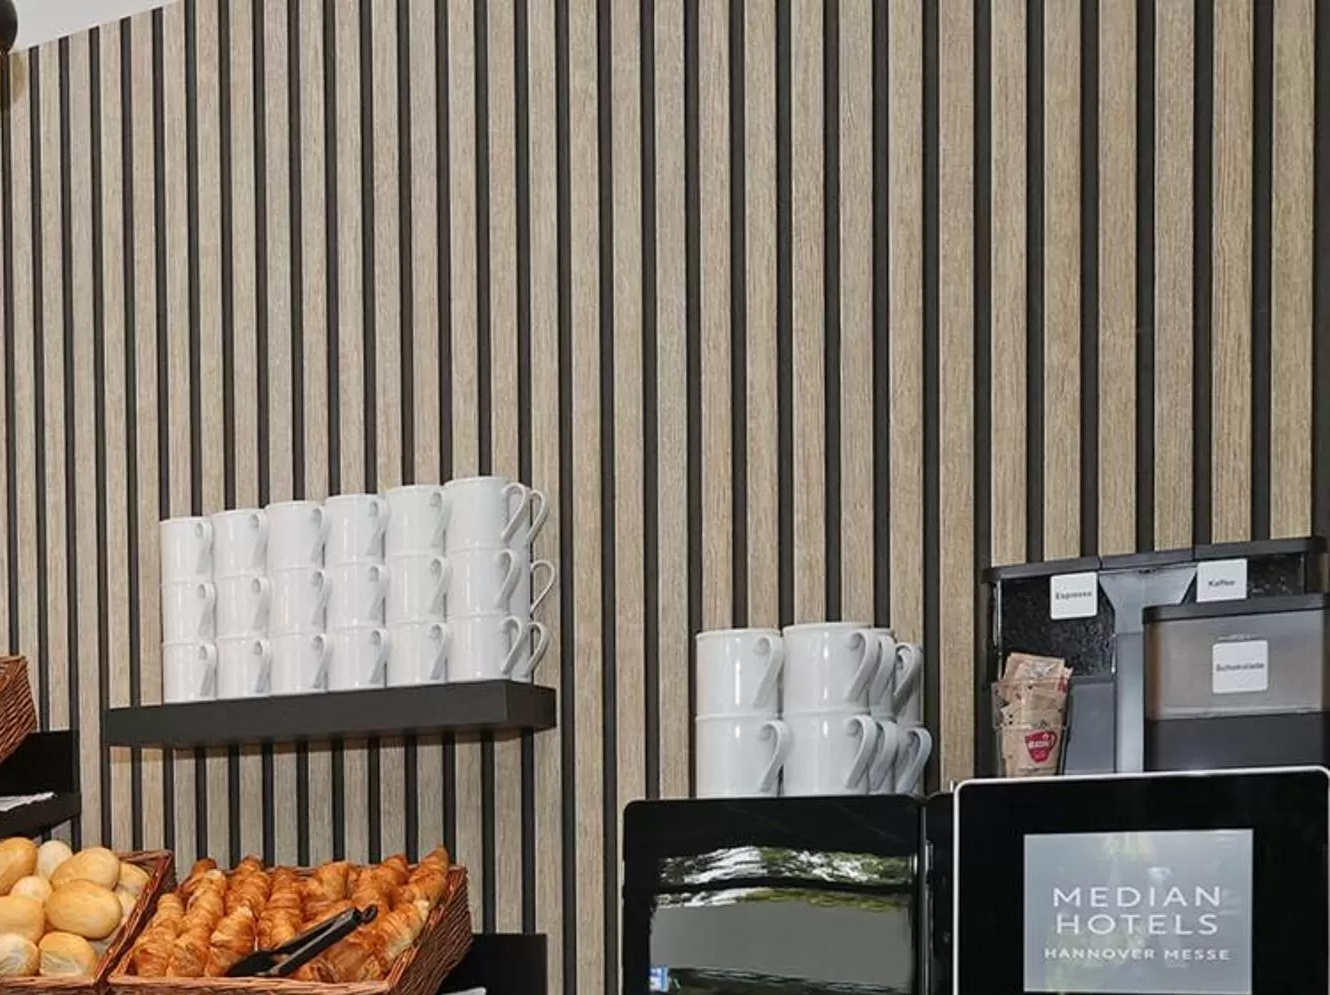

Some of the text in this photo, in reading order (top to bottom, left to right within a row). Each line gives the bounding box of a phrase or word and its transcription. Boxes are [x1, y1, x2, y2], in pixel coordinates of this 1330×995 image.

[1053, 886, 1220, 908] MEDIAN
[1056, 913, 1219, 935] HOTELS
[1044, 947, 1231, 961] HANNOVER MESSE
